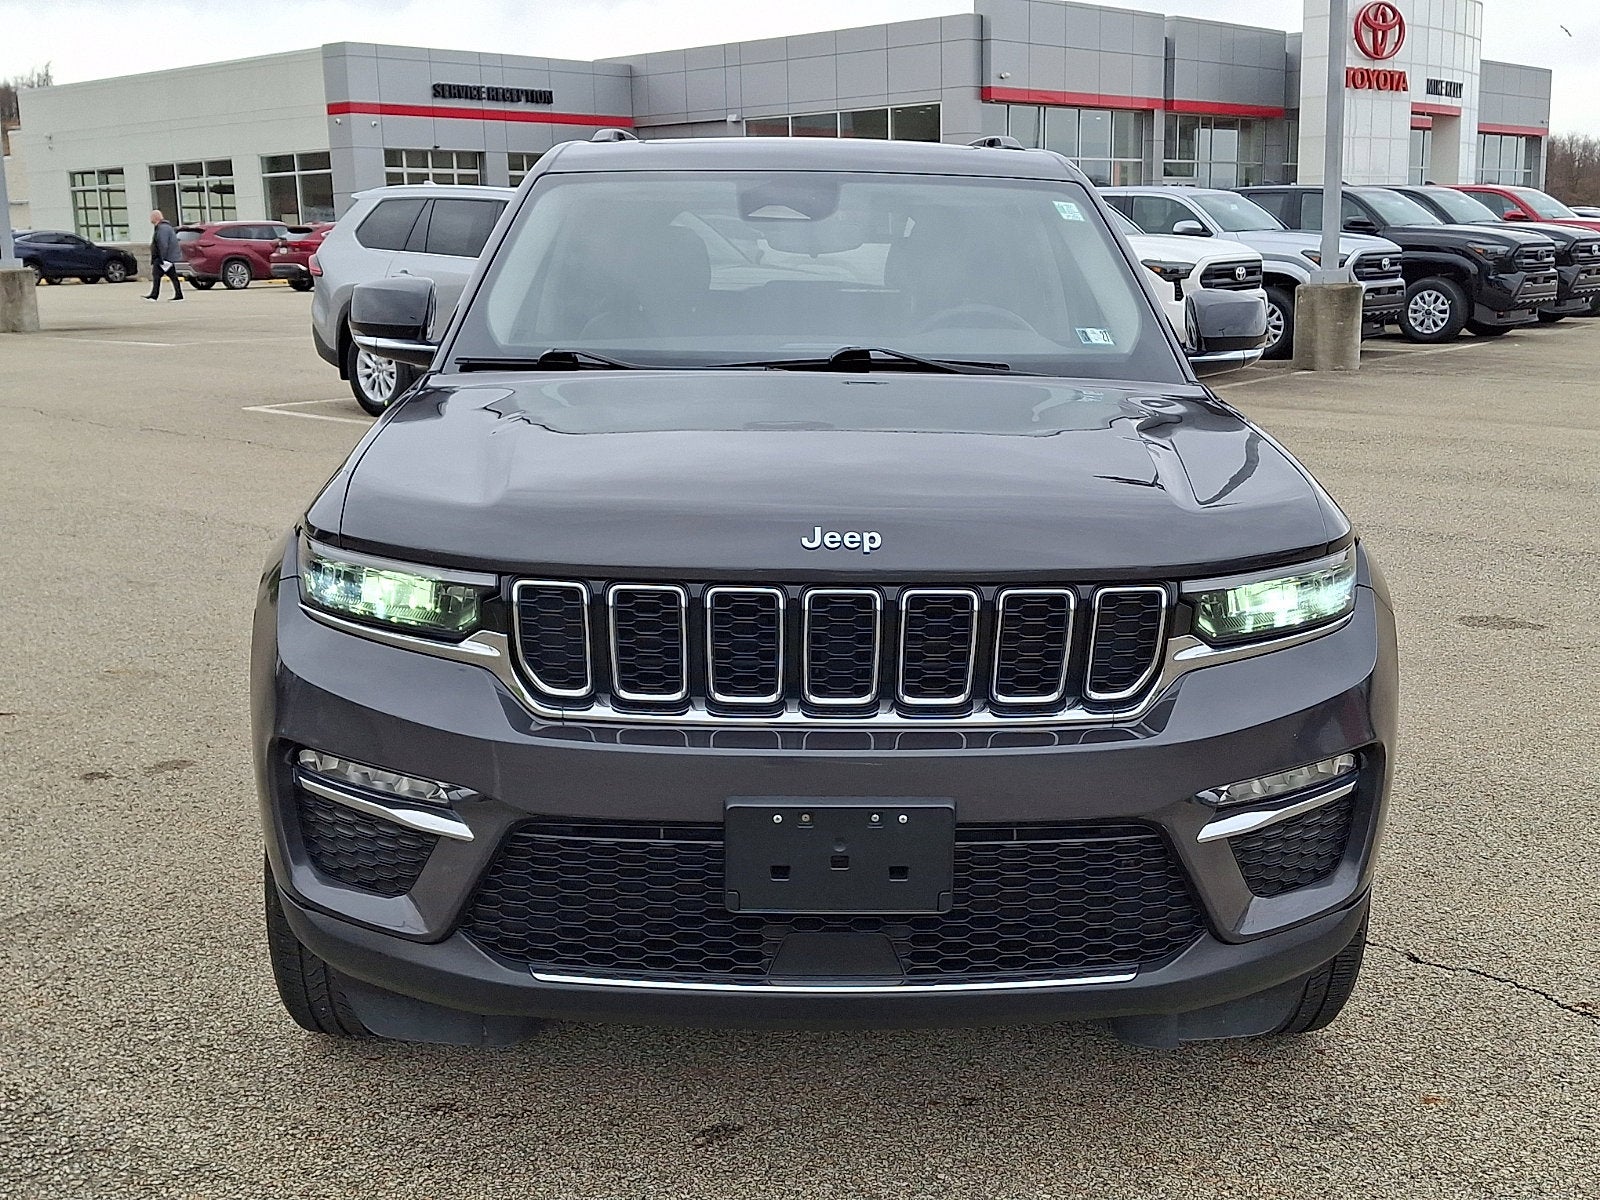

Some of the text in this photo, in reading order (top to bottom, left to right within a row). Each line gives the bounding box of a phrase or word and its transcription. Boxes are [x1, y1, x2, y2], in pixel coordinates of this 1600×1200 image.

[1345, 67, 1408, 92] TOYOTA
[1426, 78, 1445, 96] MIKE
[432, 83, 553, 104] SERVICE RECEPTION
[801, 526, 882, 554] Jeep
